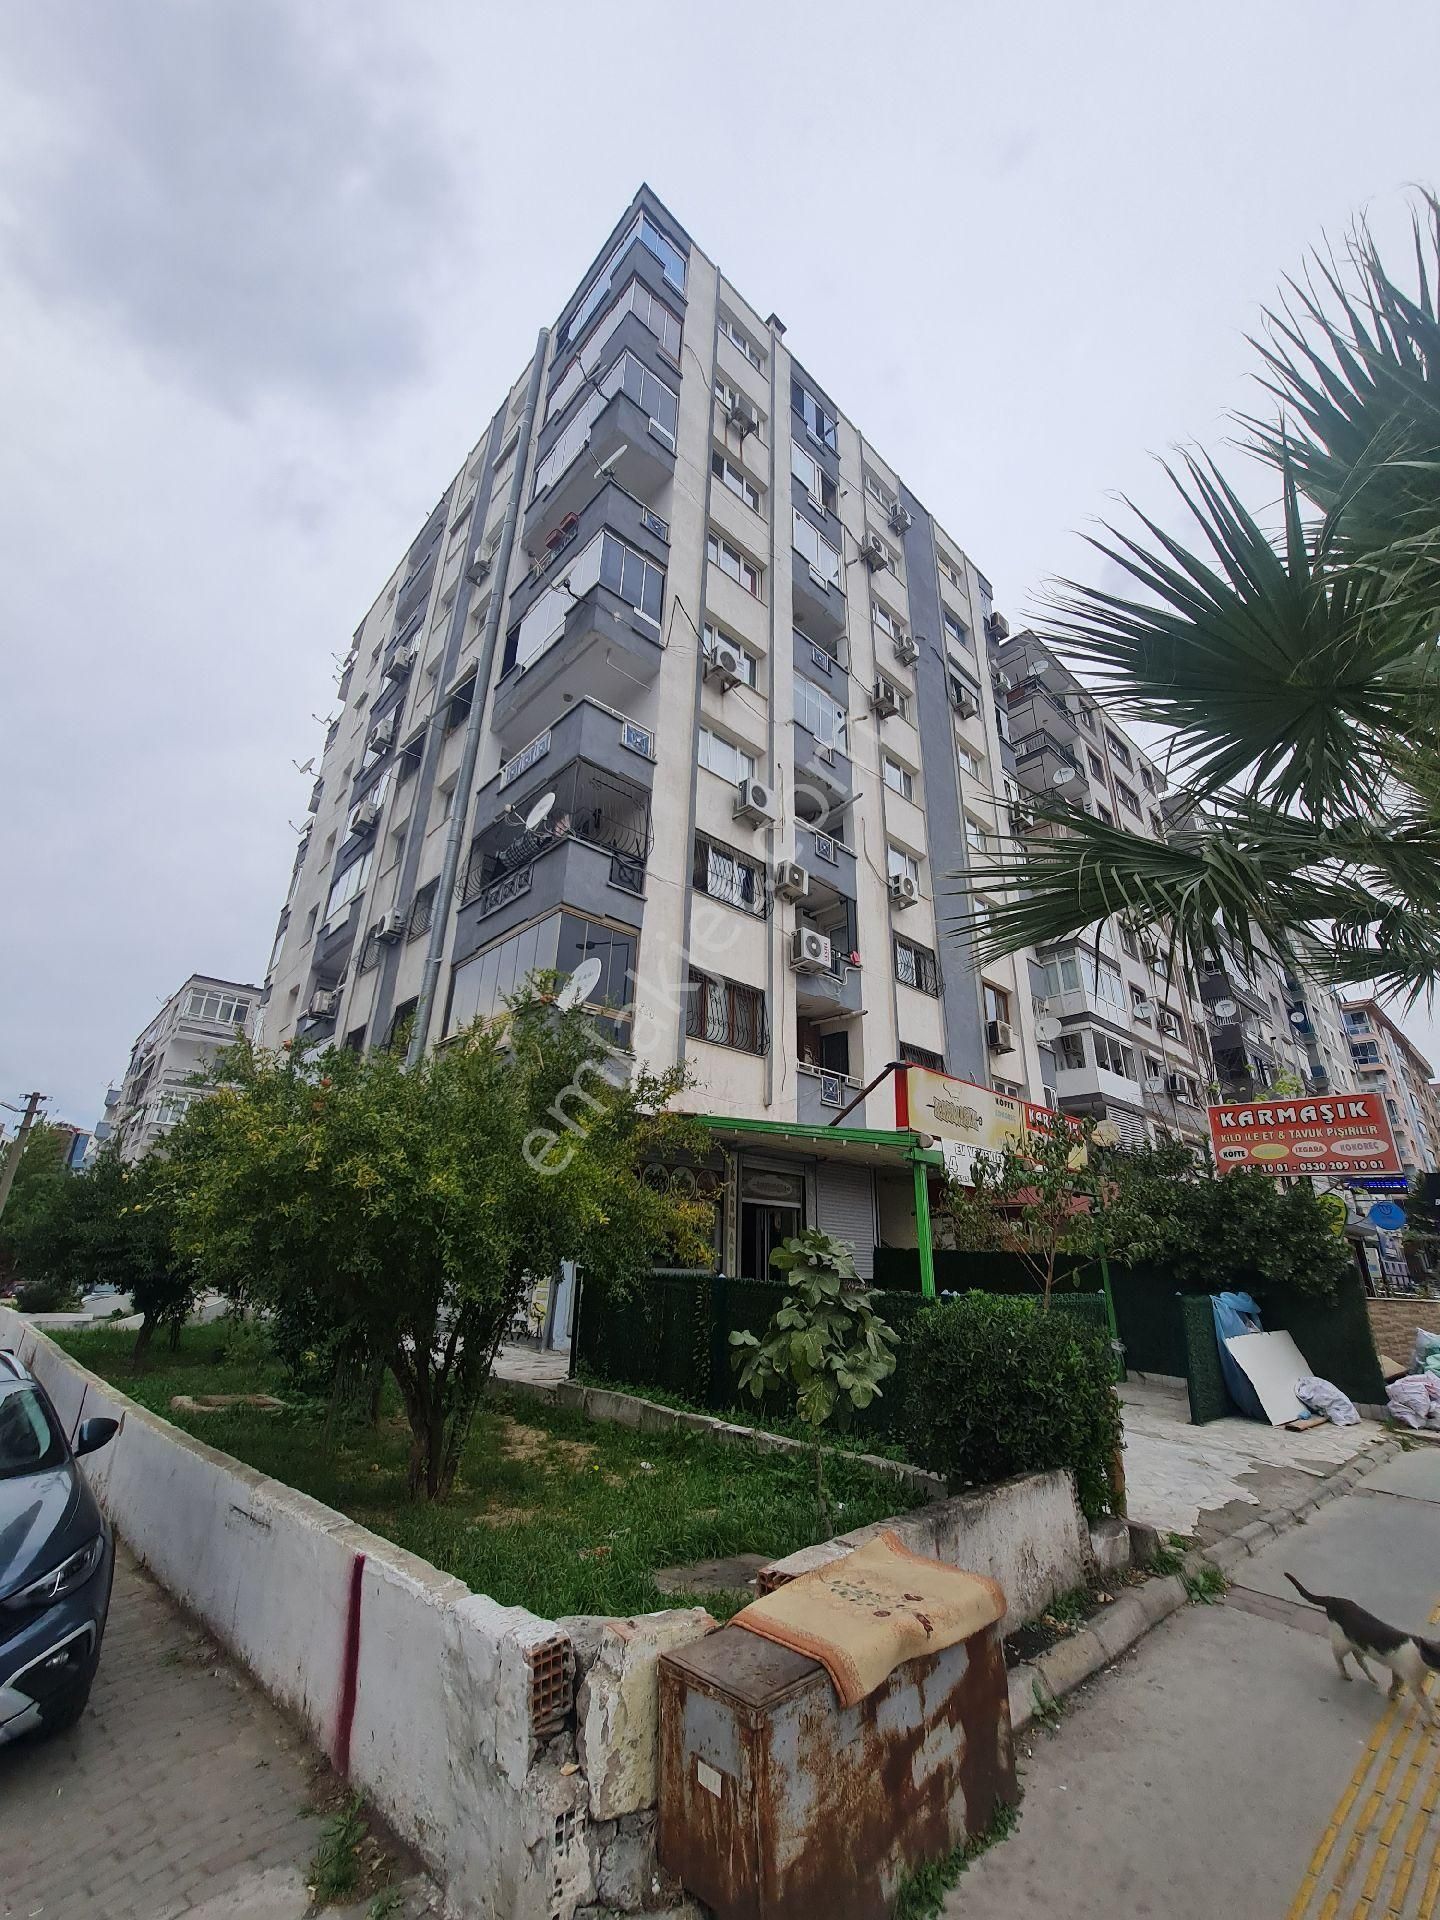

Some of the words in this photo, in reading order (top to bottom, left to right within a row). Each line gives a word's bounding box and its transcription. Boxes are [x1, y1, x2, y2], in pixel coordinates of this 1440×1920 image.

[1219, 1101, 1369, 1128] KARMAŞIK
[1262, 1131, 1274, 1140] ET
[1278, 1131, 1285, 1140] &
[1289, 1128, 1324, 1139] TAVUK
[1340, 1141, 1379, 1151] KOKOREÇ
[1223, 1149, 1246, 1158] KÖFTE
[1299, 1162, 1326, 1171] 0530
[1329, 1160, 1350, 1170] 209
[1353, 1160, 1367, 1170] 10
[1369, 1160, 1384, 1169] 01
